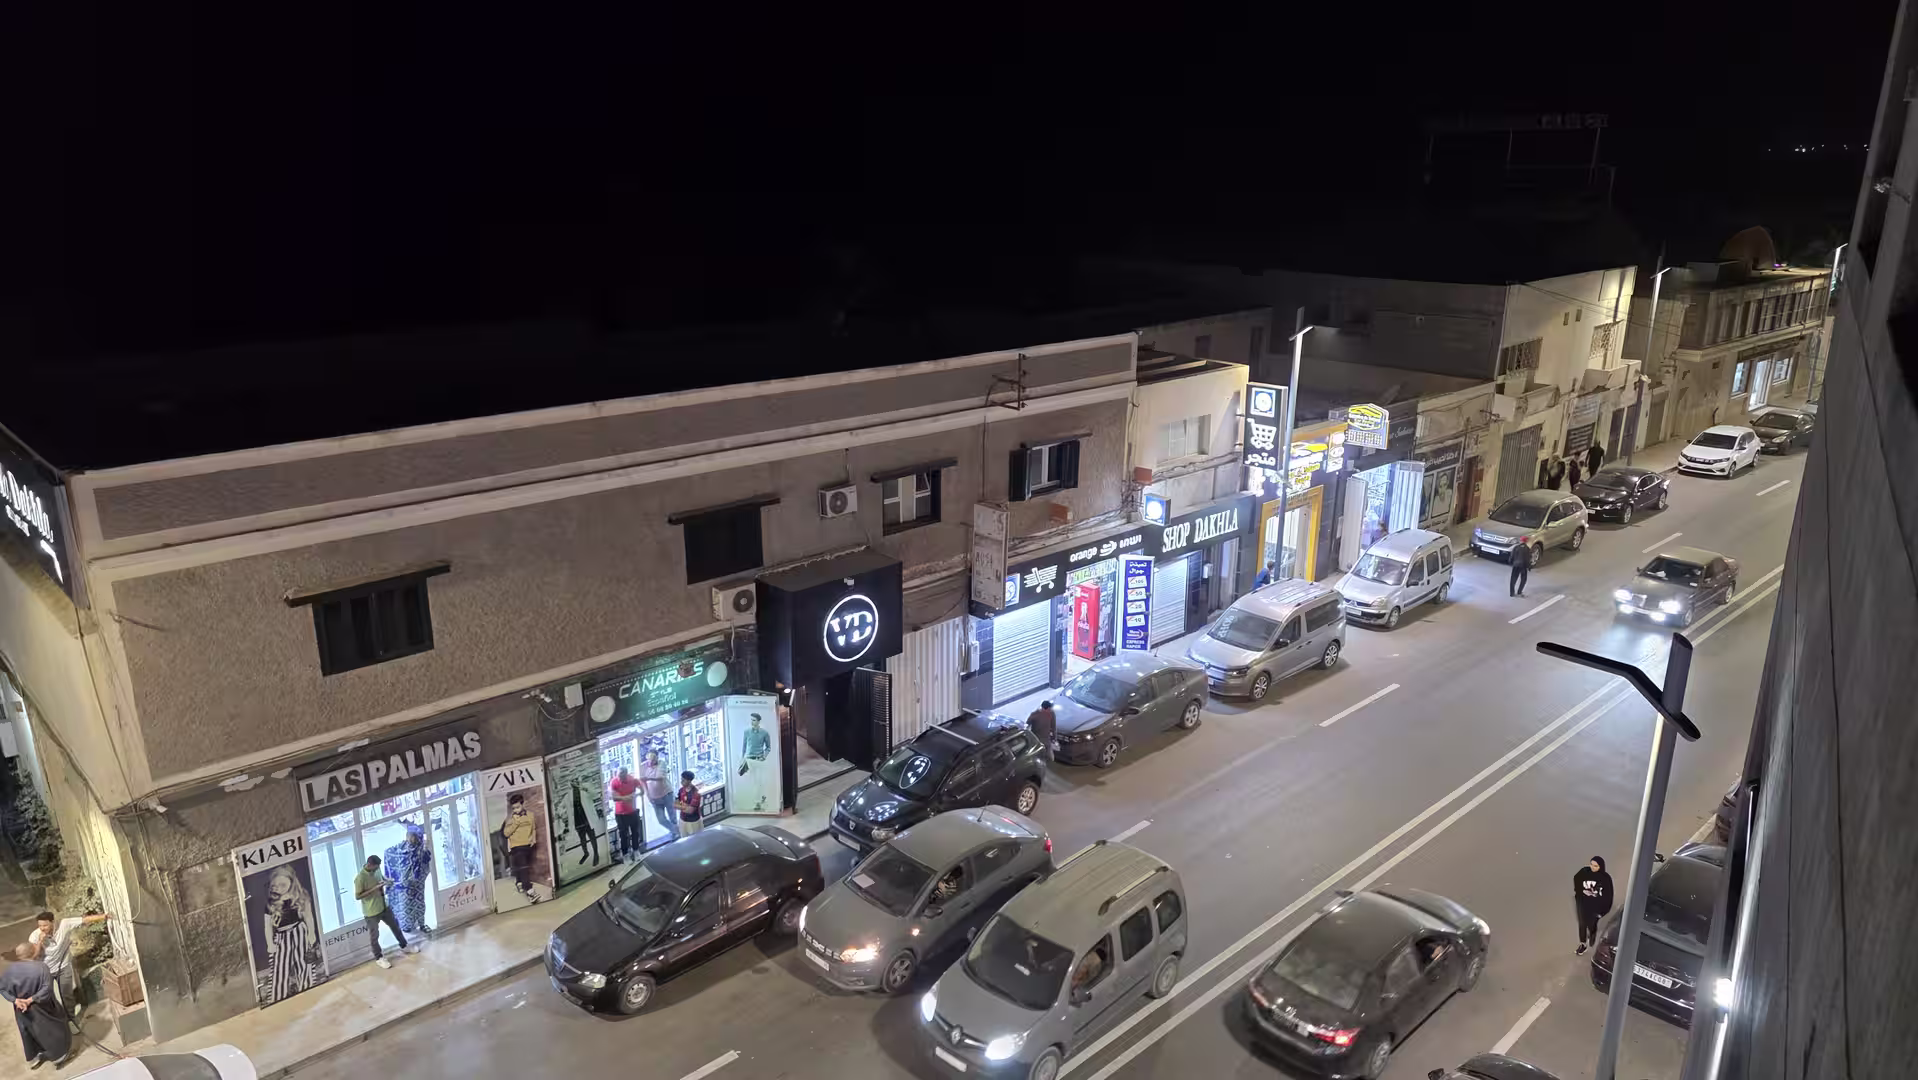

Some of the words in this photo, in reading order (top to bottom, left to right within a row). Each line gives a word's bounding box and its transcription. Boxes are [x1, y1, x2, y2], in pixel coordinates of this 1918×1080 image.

[1244, 452, 1276, 466] متجر
[1162, 521, 1190, 553] SHOP
[1193, 507, 1239, 543] DAKHLA
[1069, 546, 1097, 562] orange
[619, 661, 704, 699] CANARS
[306, 768, 363, 809] LAS
[368, 731, 482, 789] PALMAS
[487, 768, 535, 791] ZARA
[242, 836, 303, 869] KIABI
